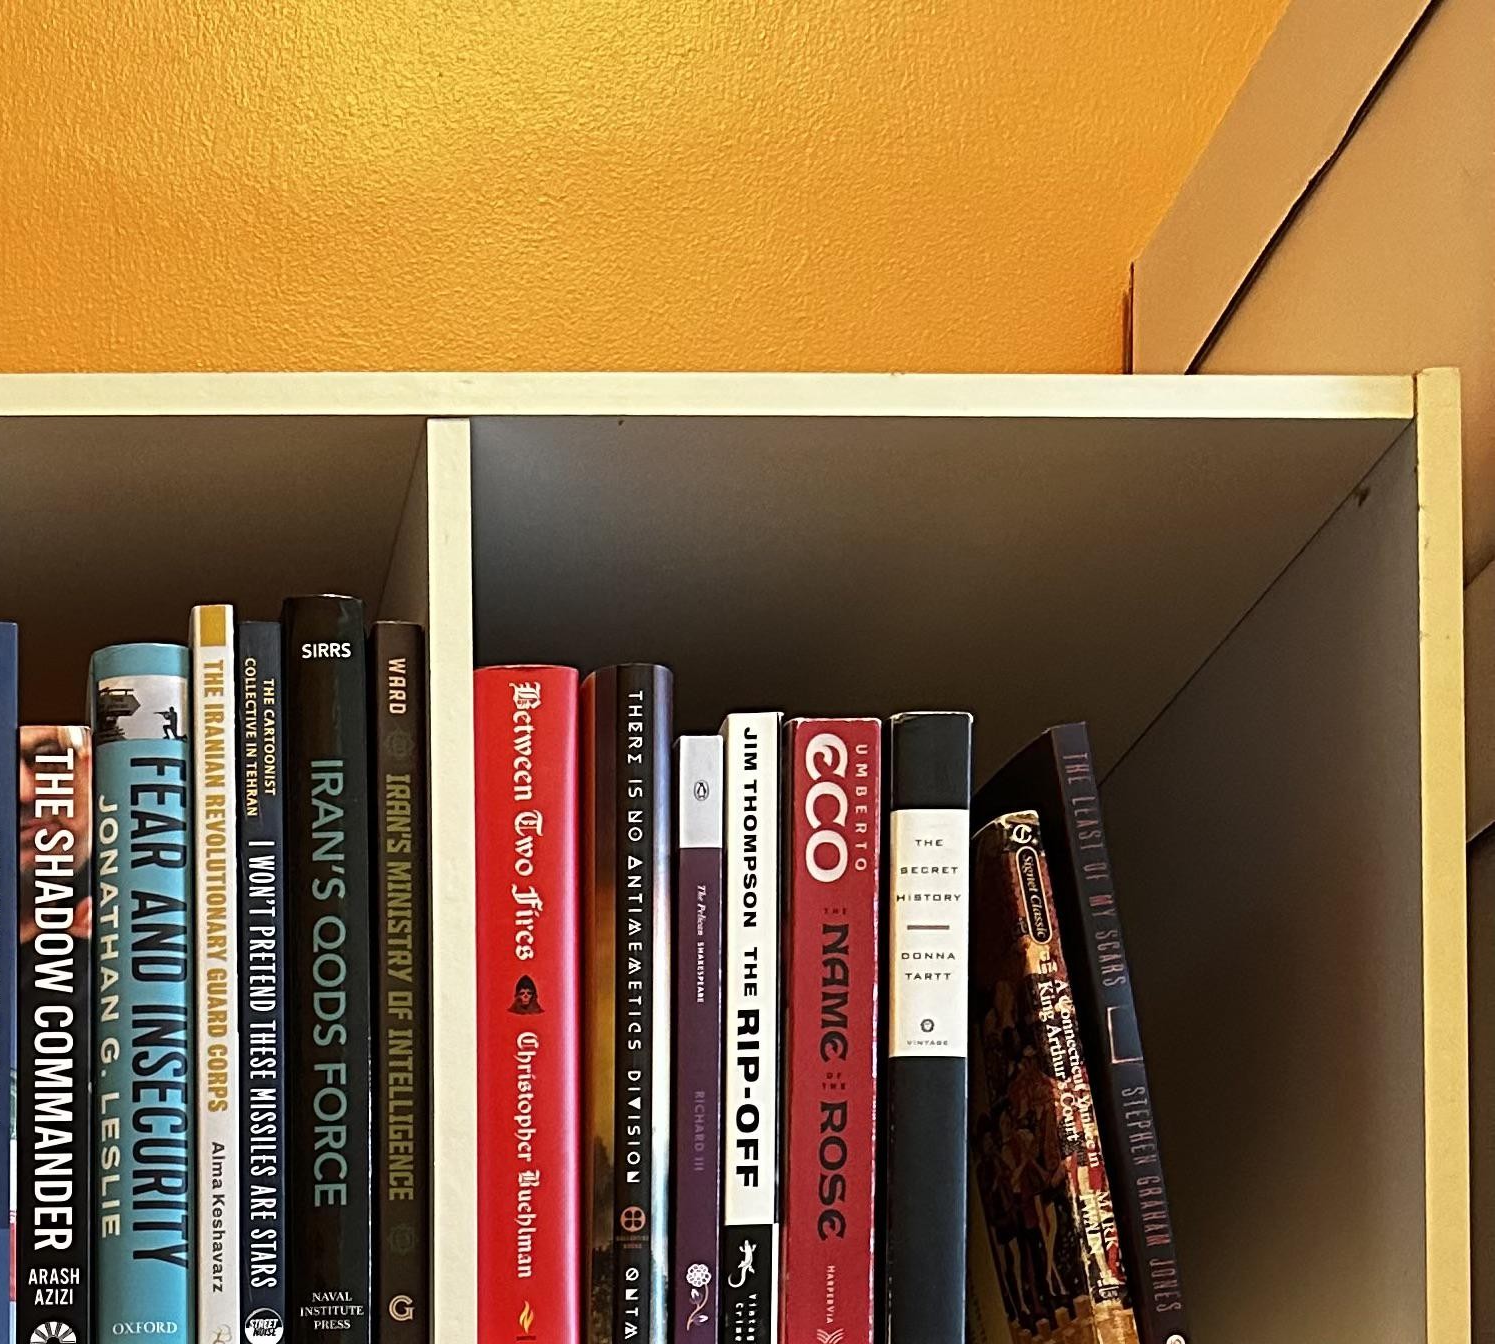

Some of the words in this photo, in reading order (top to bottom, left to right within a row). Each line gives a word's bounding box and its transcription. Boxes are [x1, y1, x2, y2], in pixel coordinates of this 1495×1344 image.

[33, 748, 74, 819] THE
[507, 681, 542, 801] Between
[743, 727, 757, 772] JIM
[129, 756, 184, 869] FEAR
[512, 810, 543, 876] Two
[743, 780, 757, 927] THOMPSON
[806, 733, 848, 882] ECO
[855, 744, 867, 872] UMBERTO
[915, 839, 944, 847] THE
[32, 828, 75, 994] SHADOW
[512, 884, 542, 960] Fires
[897, 894, 962, 902] HISTORY
[900, 866, 958, 874] SECRET
[130, 891, 186, 983] AND
[743, 947, 757, 997] THE
[821, 923, 849, 1061] NAME
[902, 952, 955, 960] DONNA
[33, 1005, 74, 1251] COMMANDER
[131, 1006, 189, 1269] INSECURITY
[514, 1032, 539, 1163] Christopher
[736, 1009, 759, 1188] RIP-OFF
[515, 1169, 539, 1278] Buehlman
[818, 1100, 848, 1242] ROSE
